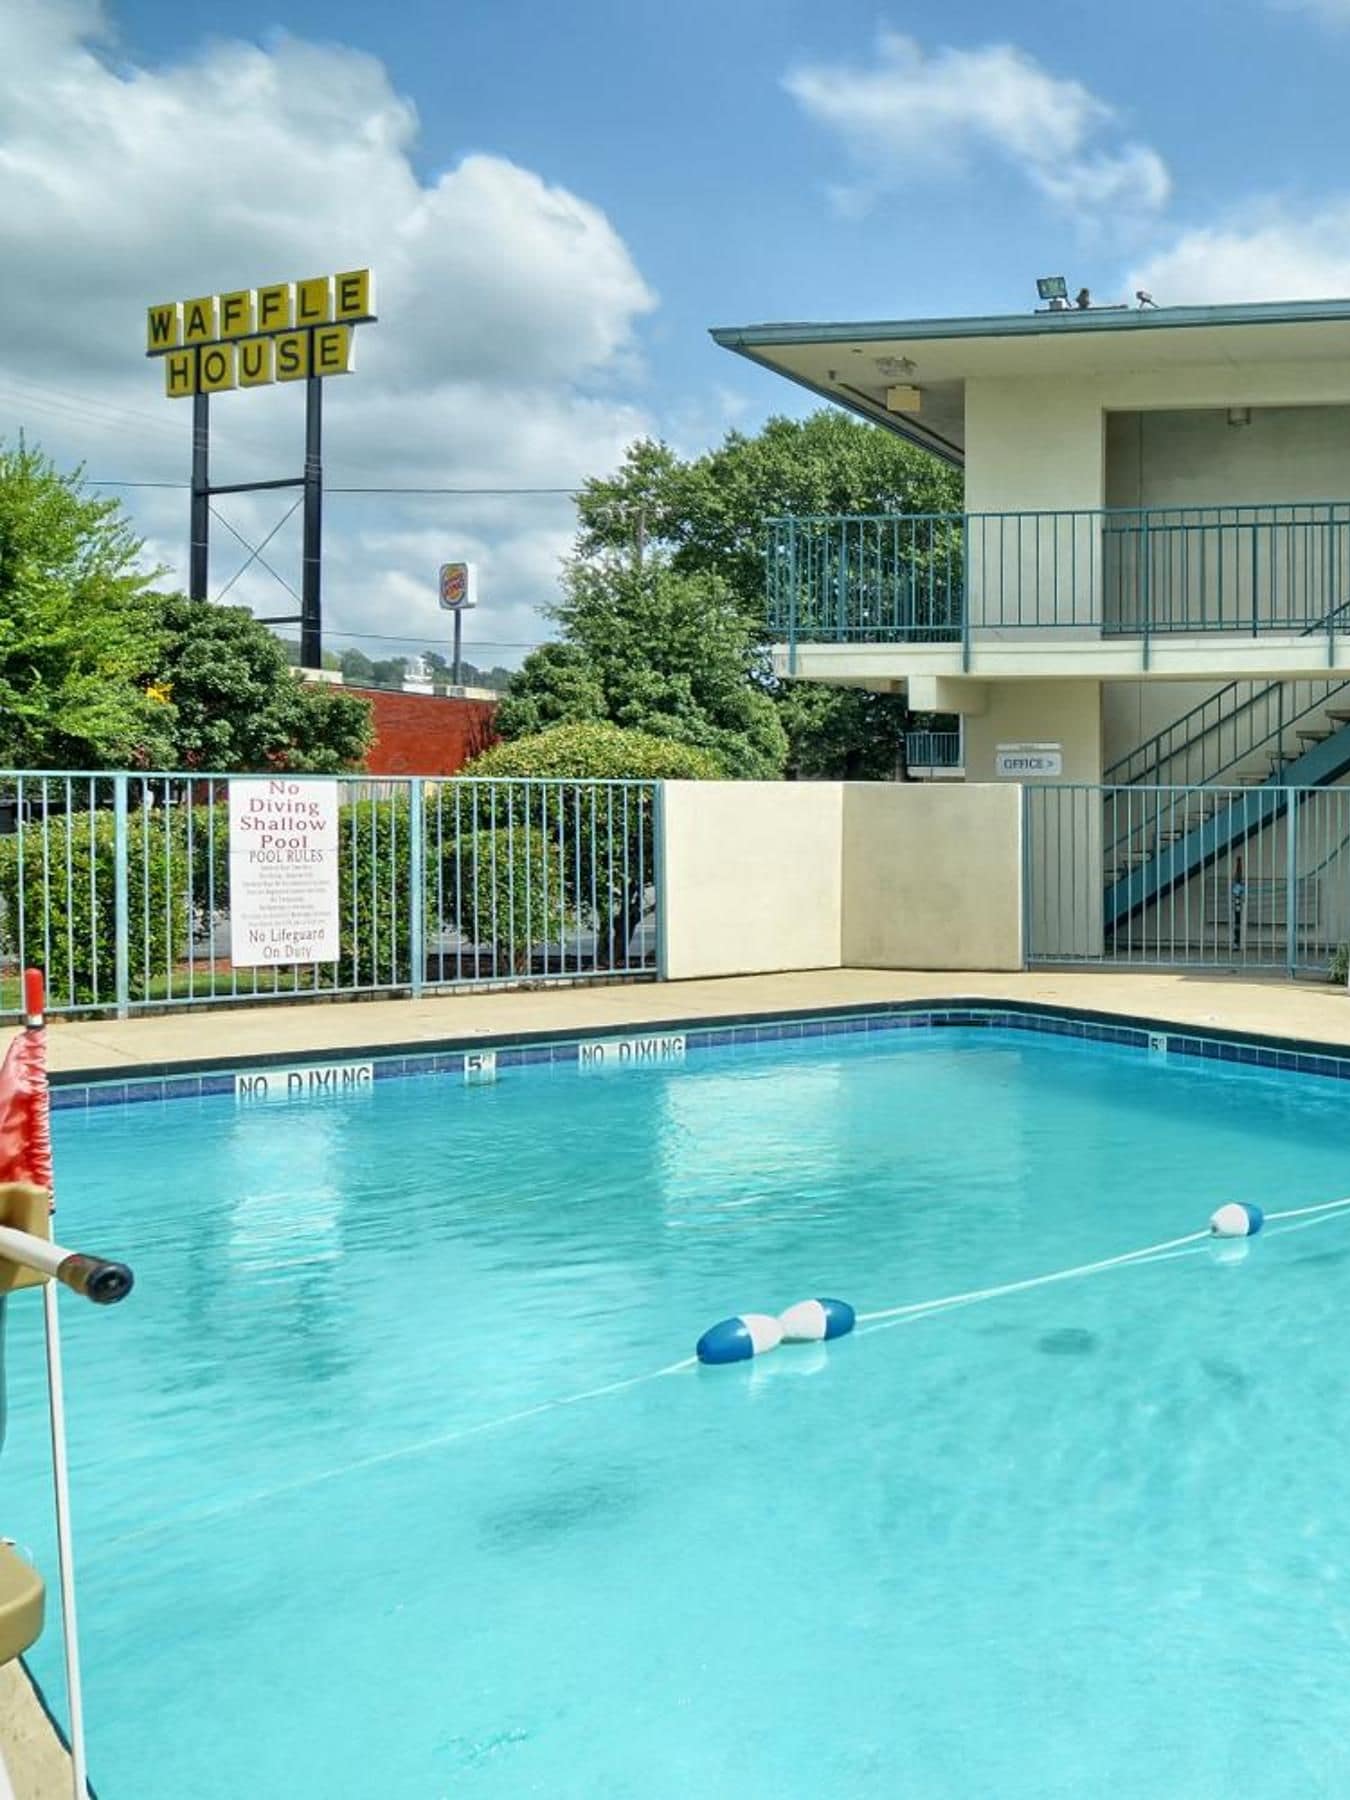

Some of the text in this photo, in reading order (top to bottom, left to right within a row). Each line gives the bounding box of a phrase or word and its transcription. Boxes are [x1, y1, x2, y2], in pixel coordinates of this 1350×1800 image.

[150, 277, 361, 344] WAFFLE
[169, 333, 340, 390] HOUSE
[1003, 758, 1043, 769] OFFICE
[269, 780, 300, 795] No
[250, 798, 320, 817] Diving
[240, 816, 327, 831] Shallow
[261, 834, 308, 849] Pool
[249, 849, 324, 864] POOL RULES
[249, 928, 325, 944] No Lifeguard
[263, 945, 312, 959] On Duty
[580, 1038, 683, 1064] NO DIVING
[240, 1067, 370, 1096] NO DIVING
